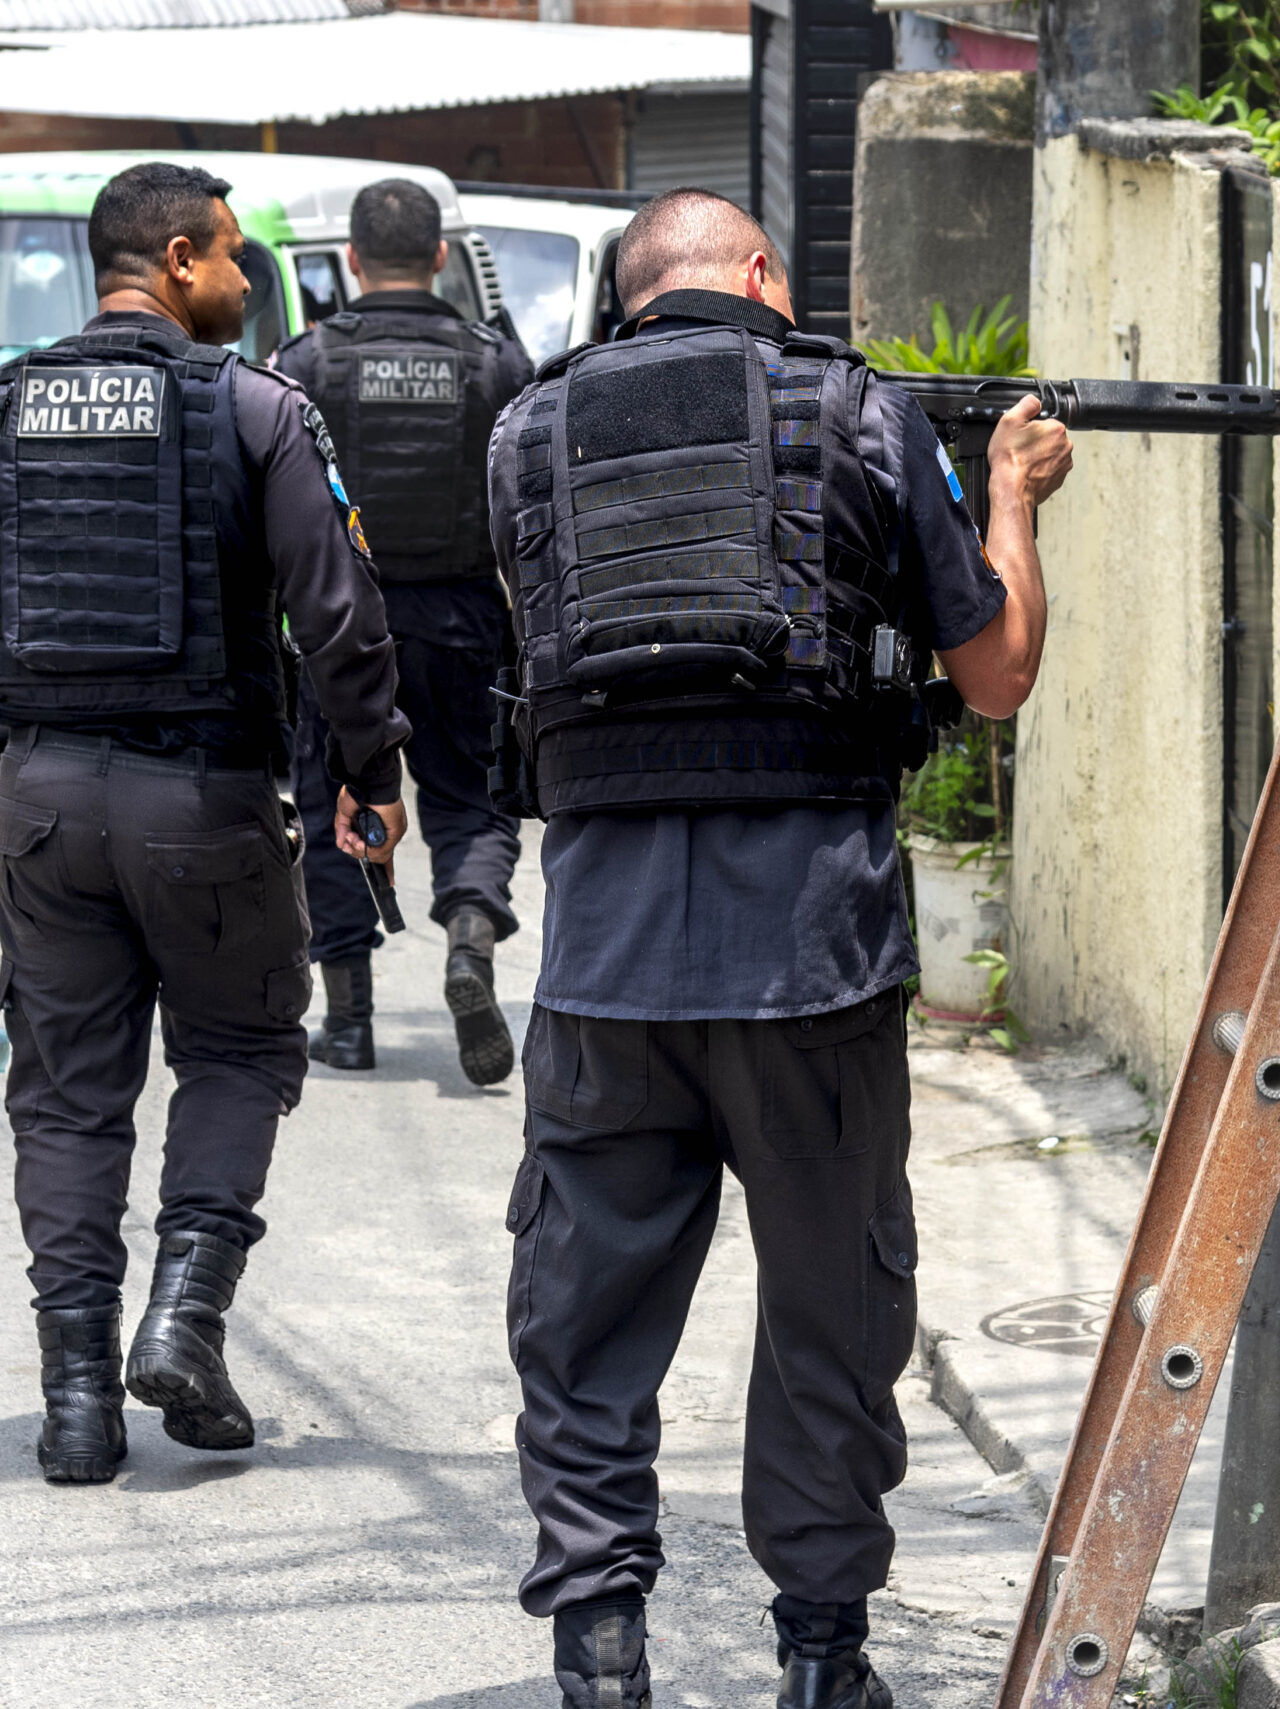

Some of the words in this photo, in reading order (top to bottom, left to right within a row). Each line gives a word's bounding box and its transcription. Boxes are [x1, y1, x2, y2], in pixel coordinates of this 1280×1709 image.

[362, 356, 452, 380] POLÍCIA
[25, 372, 155, 404] POLÍCIA
[363, 380, 453, 399] MILITAR
[22, 406, 155, 432] MILITAR
